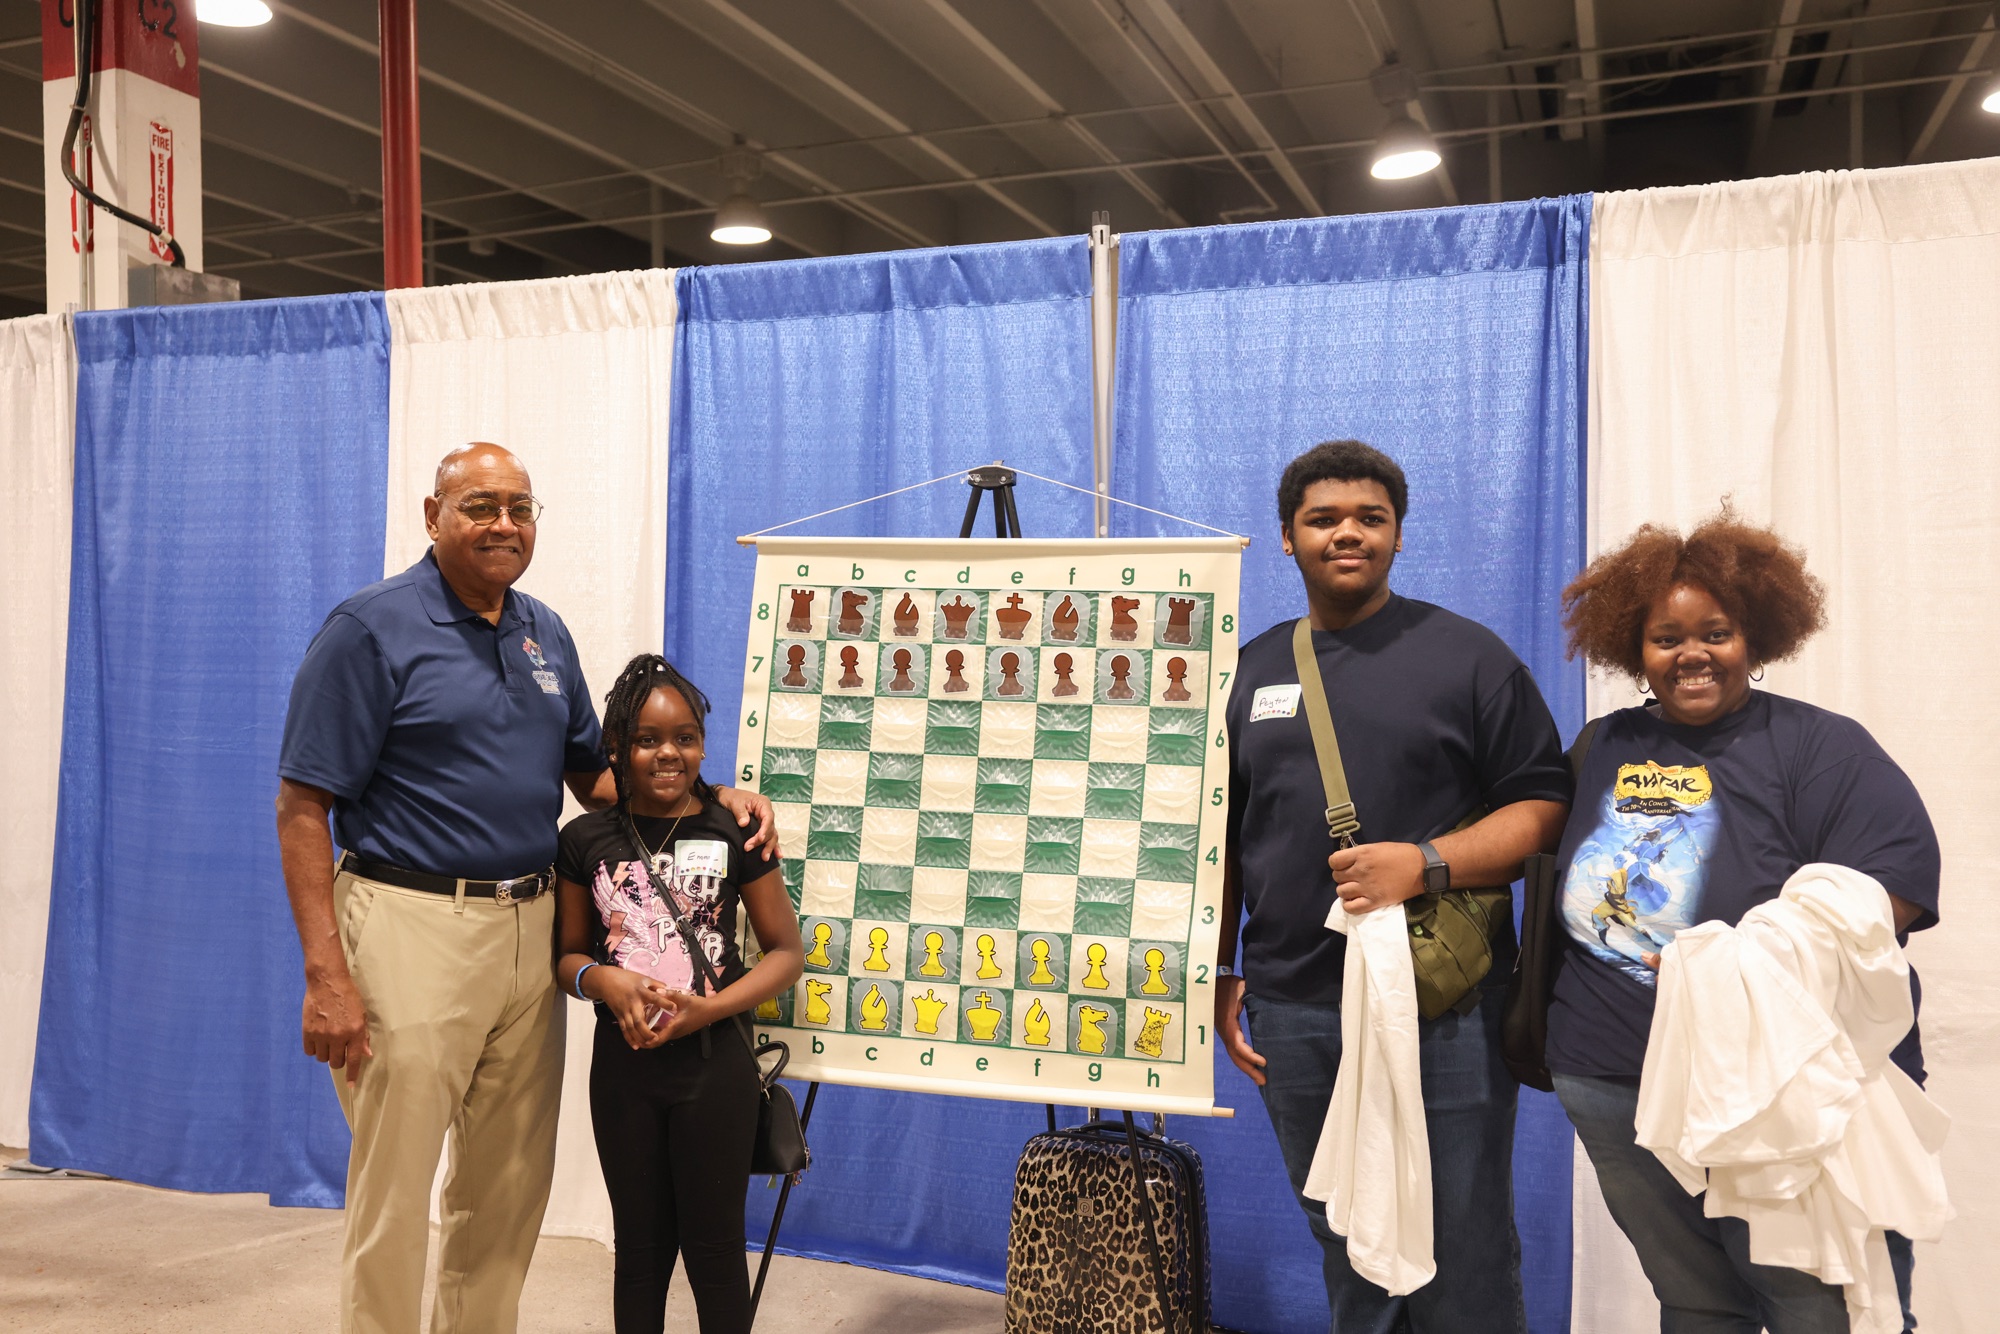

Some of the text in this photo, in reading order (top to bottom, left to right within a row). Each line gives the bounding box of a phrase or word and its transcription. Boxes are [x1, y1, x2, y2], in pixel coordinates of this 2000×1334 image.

[152, 133, 170, 151] FIRE
[157, 152, 166, 249] EXTINGUISR
[797, 563, 1191, 587] a b c d e f g h
[757, 603, 770, 620] 8
[1221, 614, 1234, 633] 8
[752, 656, 764, 673] 7
[1219, 672, 1230, 690] 7
[746, 710, 758, 728] 6
[1215, 733, 1225, 748] 6
[741, 765, 753, 782] 5
[1622, 772, 1703, 792] AVATAR
[1211, 787, 1224, 806] 5
[1205, 846, 1218, 865] 4
[1201, 905, 1215, 924] 3
[1194, 964, 1209, 984] 2
[1197, 1025, 1205, 1045] 1
[758, 1032, 1160, 1088] a b c d e f g h
